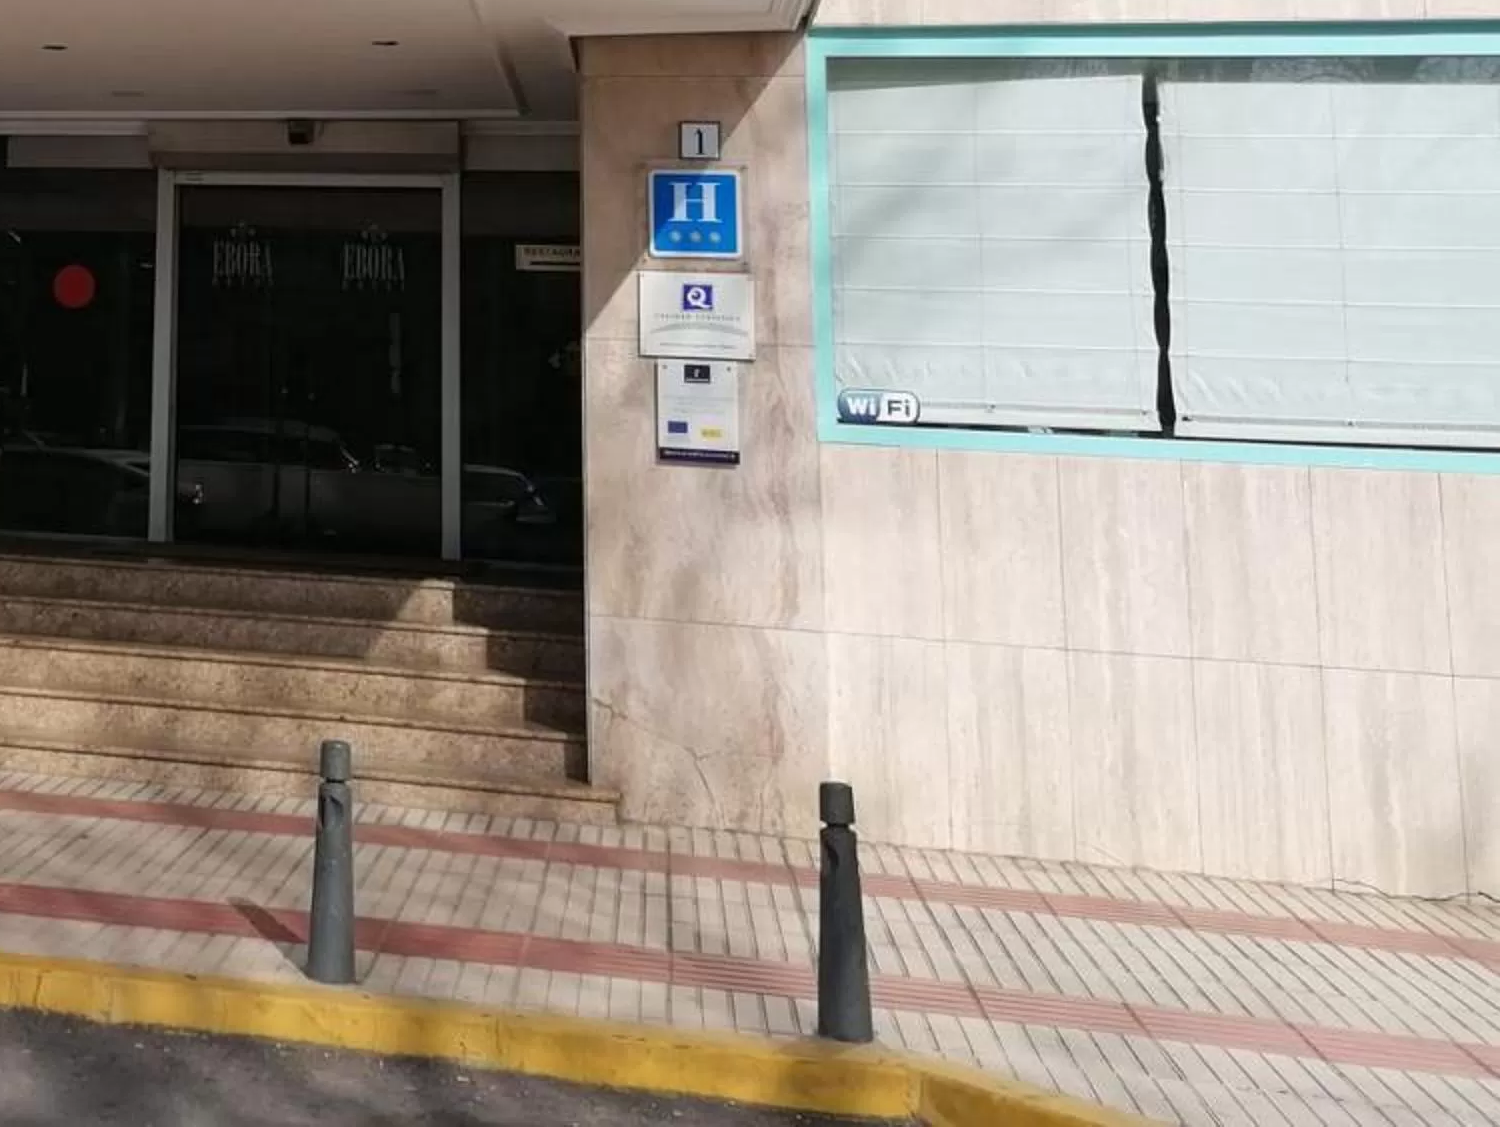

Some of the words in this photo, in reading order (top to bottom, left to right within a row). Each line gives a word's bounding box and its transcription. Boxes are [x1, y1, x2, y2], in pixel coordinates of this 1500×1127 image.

[694, 128, 705, 156] 1
[667, 181, 724, 224] H
[844, 393, 913, 420] WiFi
